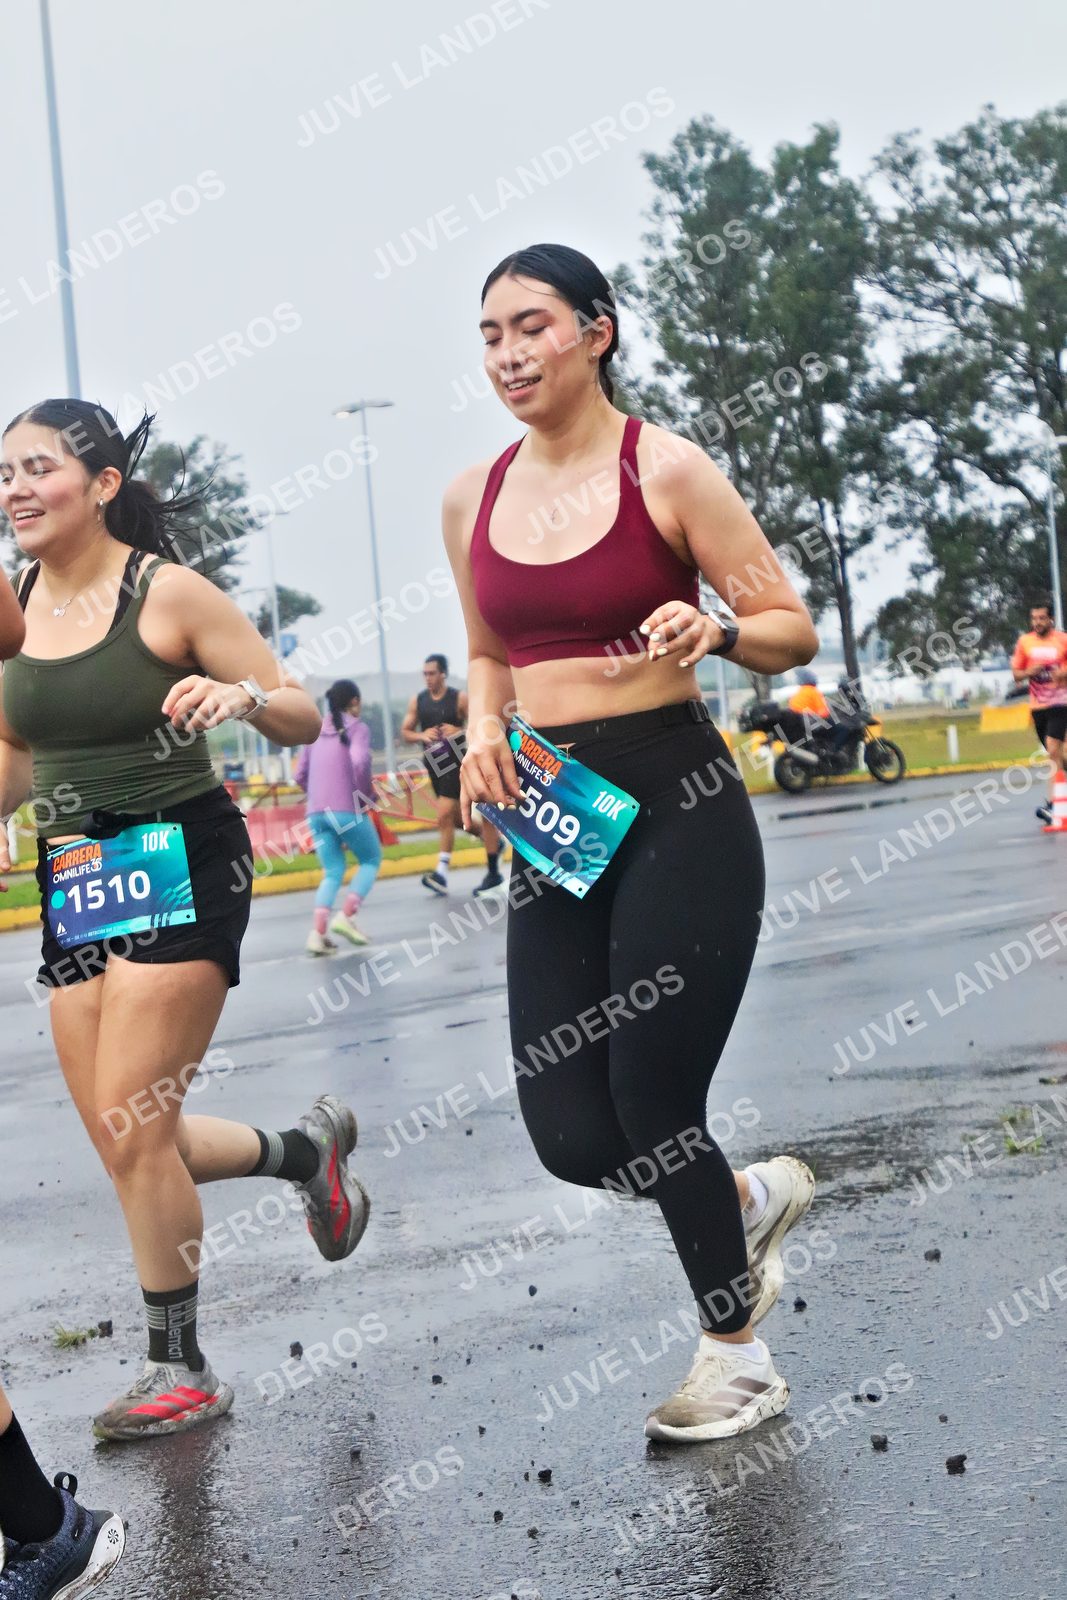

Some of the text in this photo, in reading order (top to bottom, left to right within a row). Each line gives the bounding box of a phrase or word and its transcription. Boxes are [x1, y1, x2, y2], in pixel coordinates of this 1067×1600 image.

[512, 750, 543, 780] MNILIFE
[518, 730, 563, 778] ARRERA
[517, 776, 580, 846] 509
[592, 790, 628, 821] 10K
[141, 830, 170, 853] 10K
[53, 843, 102, 873] CARRERA
[67, 870, 151, 913] 1510
